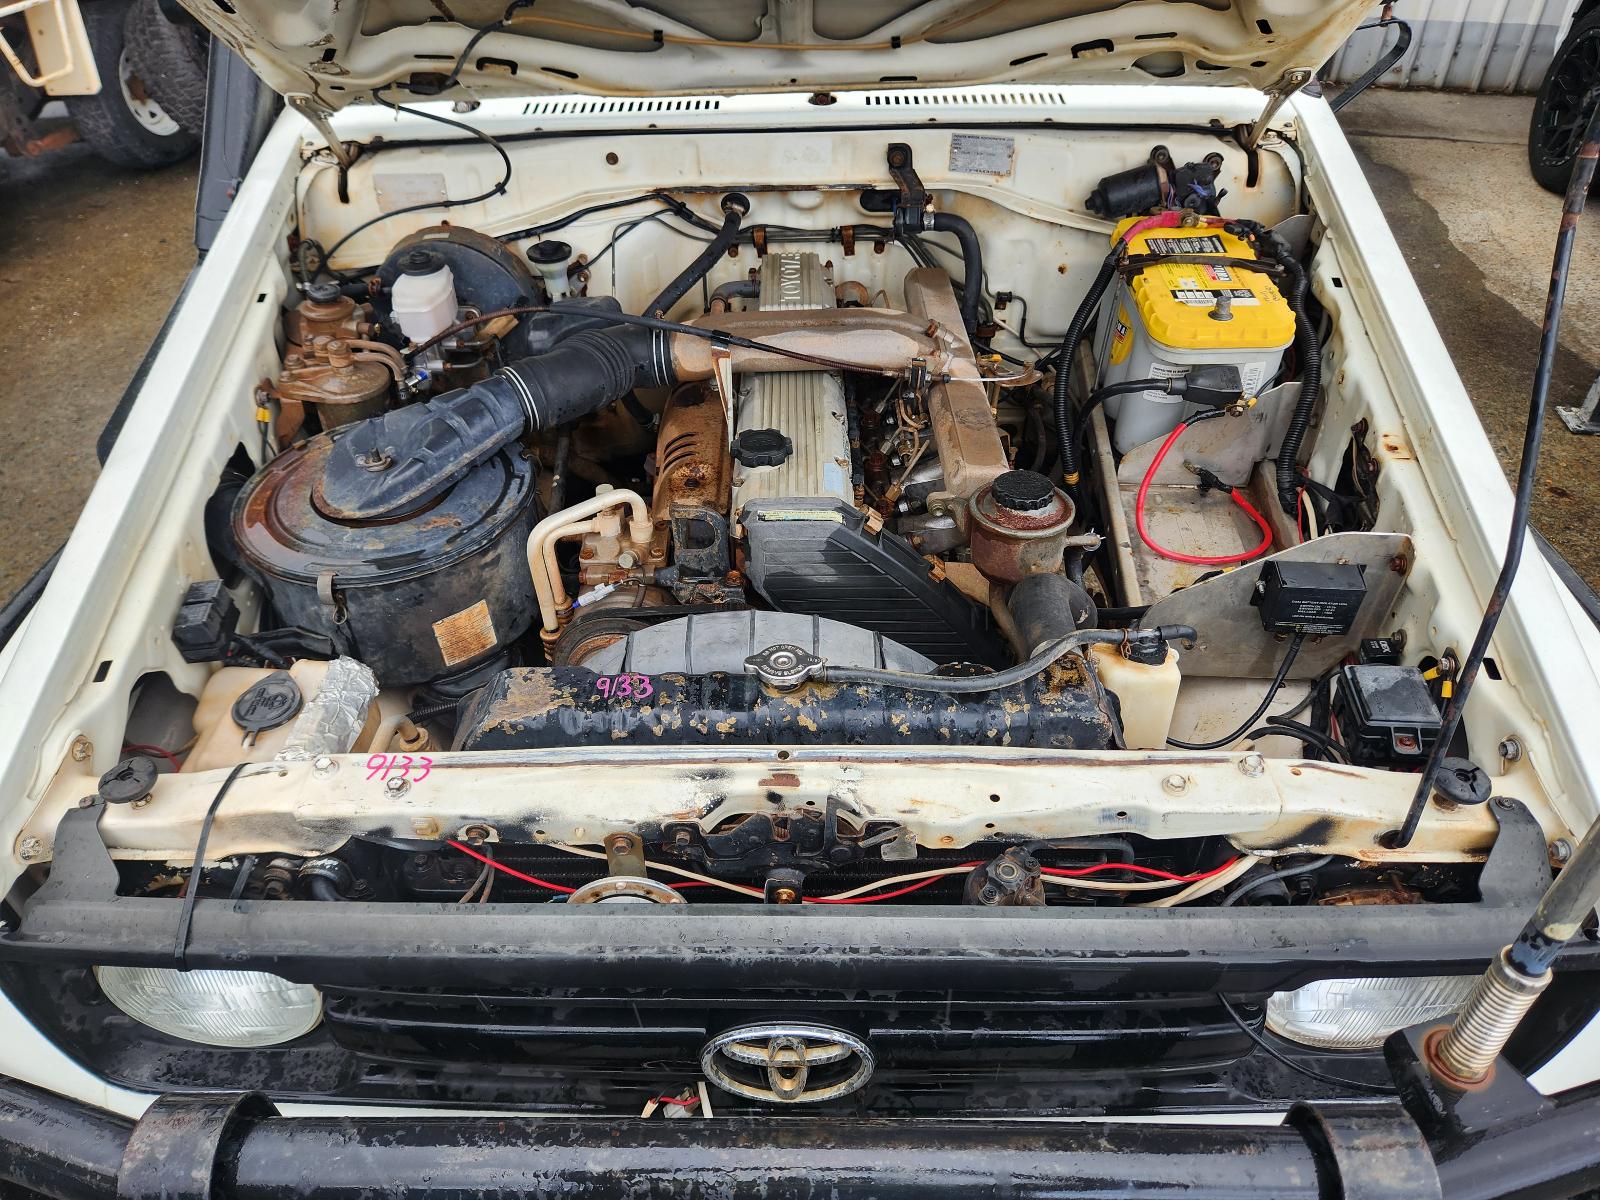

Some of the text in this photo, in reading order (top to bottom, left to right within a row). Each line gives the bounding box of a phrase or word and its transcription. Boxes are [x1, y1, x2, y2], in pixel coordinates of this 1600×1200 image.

[780, 253, 801, 302] TOYOTA
[596, 675, 654, 699] 9133
[366, 753, 433, 782] 9133
